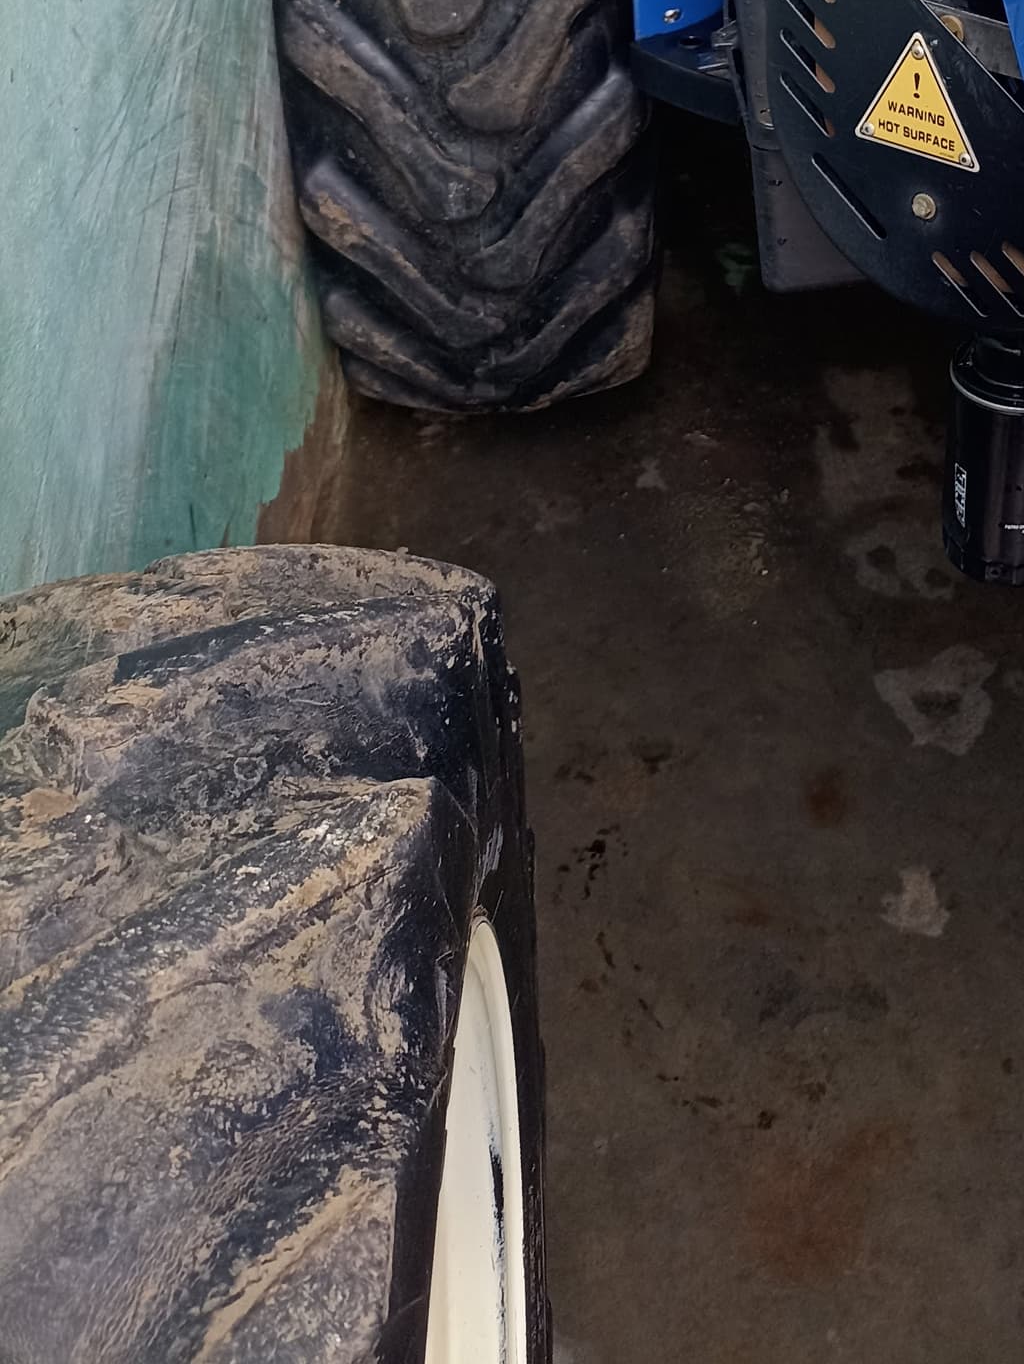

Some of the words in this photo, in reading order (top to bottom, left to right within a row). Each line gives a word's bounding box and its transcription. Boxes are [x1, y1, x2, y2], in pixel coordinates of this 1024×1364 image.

[887, 99, 946, 127] WARNING
[878, 118, 901, 134] HOT
[903, 126, 956, 152] SURFACE
